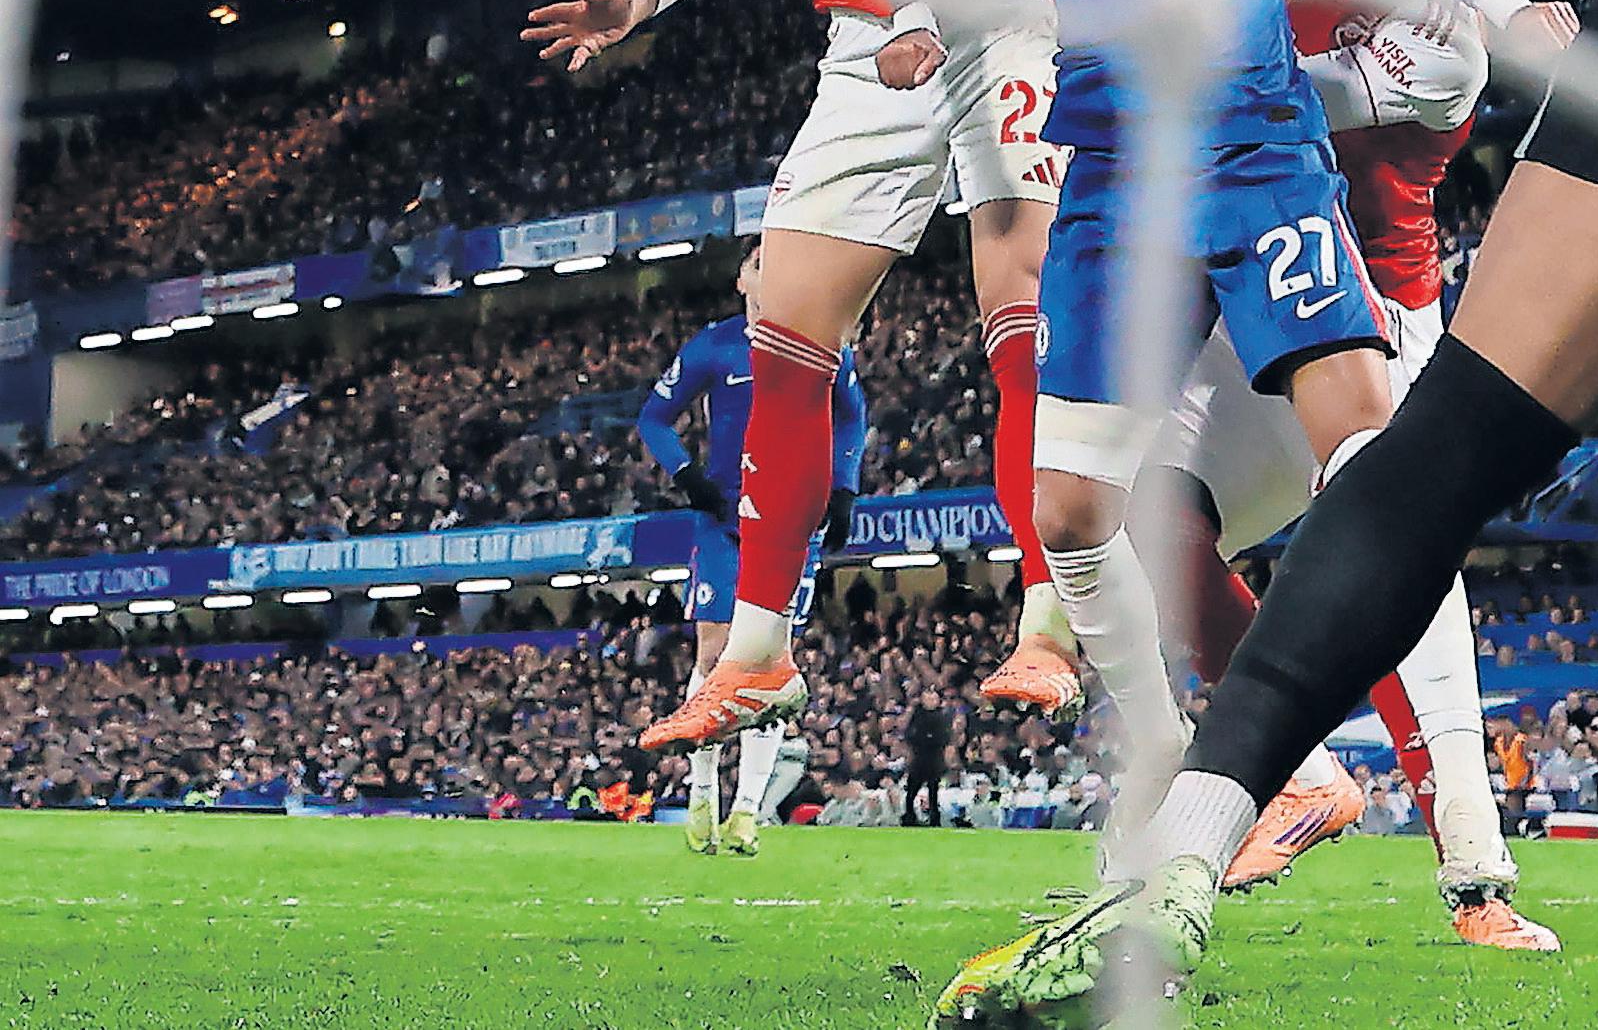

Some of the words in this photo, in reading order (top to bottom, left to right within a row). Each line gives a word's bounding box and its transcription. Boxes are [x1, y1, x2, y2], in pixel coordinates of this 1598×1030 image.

[1382, 37, 1416, 71] VISIT
[1000, 80, 1058, 145] 2
[1257, 216, 1338, 301] 27
